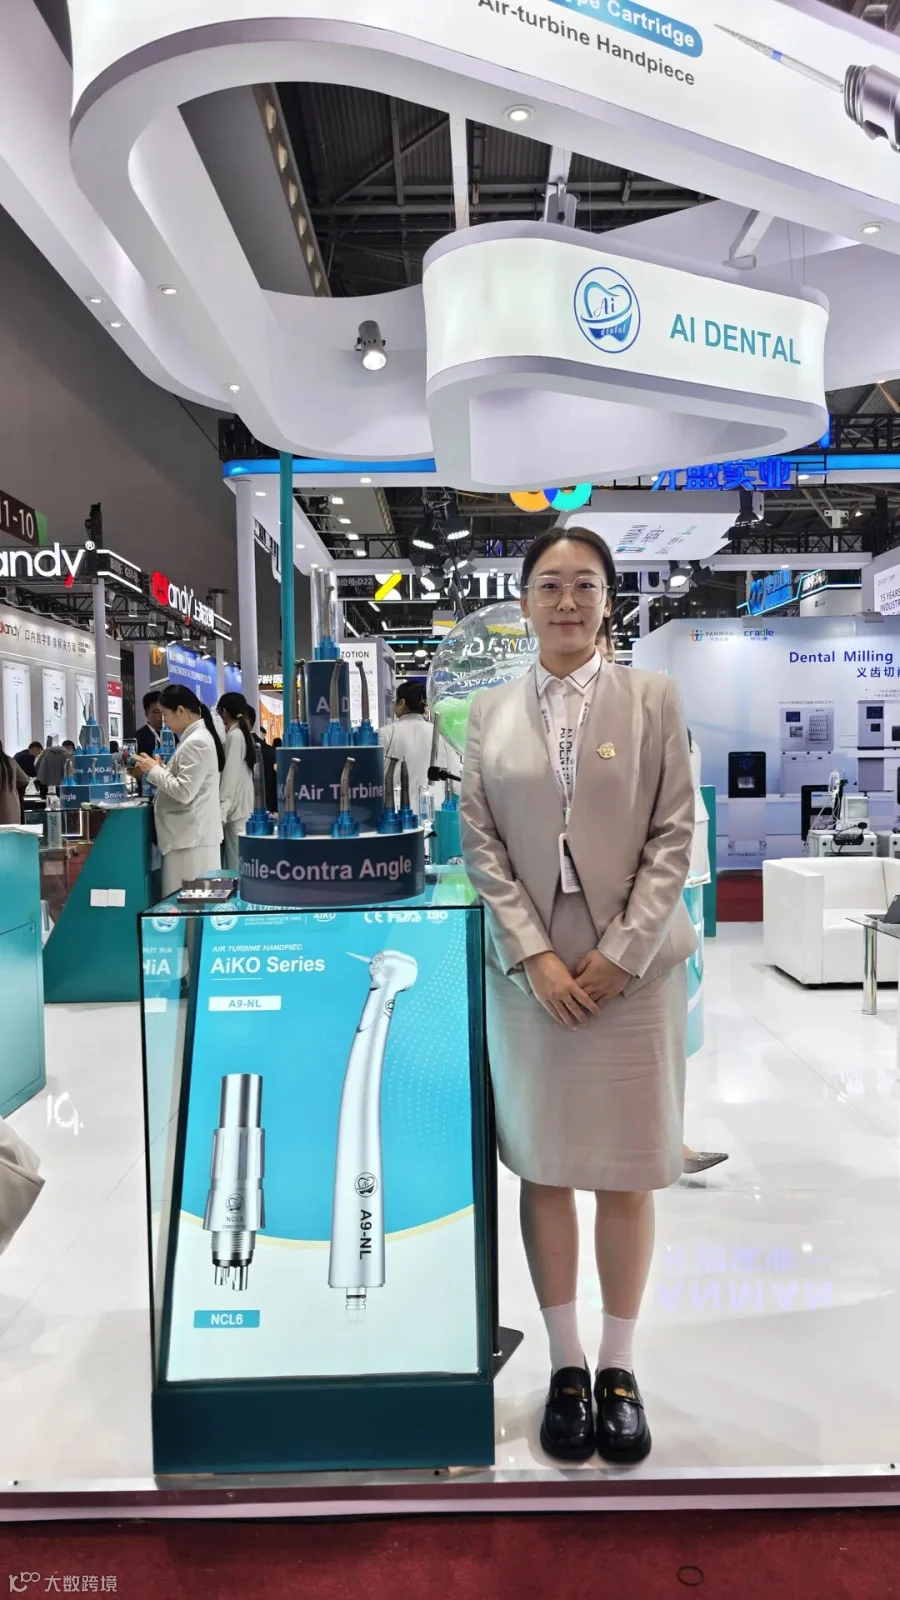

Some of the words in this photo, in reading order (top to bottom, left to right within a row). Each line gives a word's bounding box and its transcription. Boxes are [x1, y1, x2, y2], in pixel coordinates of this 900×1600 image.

[607, 0, 695, 48] Cartridge
[478, 0, 590, 46] Air-turbine
[597, 34, 695, 86] Handpiece
[669, 313, 695, 343] AI
[704, 319, 801, 365] DENTAL
[743, 628, 774, 637] cradle
[340, 651, 370, 659] ZOTION
[789, 651, 836, 663] Dental
[843, 650, 893, 664] Milling
[856, 666, 900, 678] 义齿切
[329, 783, 384, 799] Trbine
[359, 856, 412, 880] Angle
[212, 945, 226, 953] AIR
[228, 944, 261, 953] TURBINE
[263, 943, 303, 952] HANDPIEC
[210, 956, 261, 975] AiKO
[266, 955, 325, 973] Series
[228, 998, 262, 1009] A9-NL
[359, 1209, 372, 1261] A9-NL
[210, 1313, 243, 1326] NCL6
